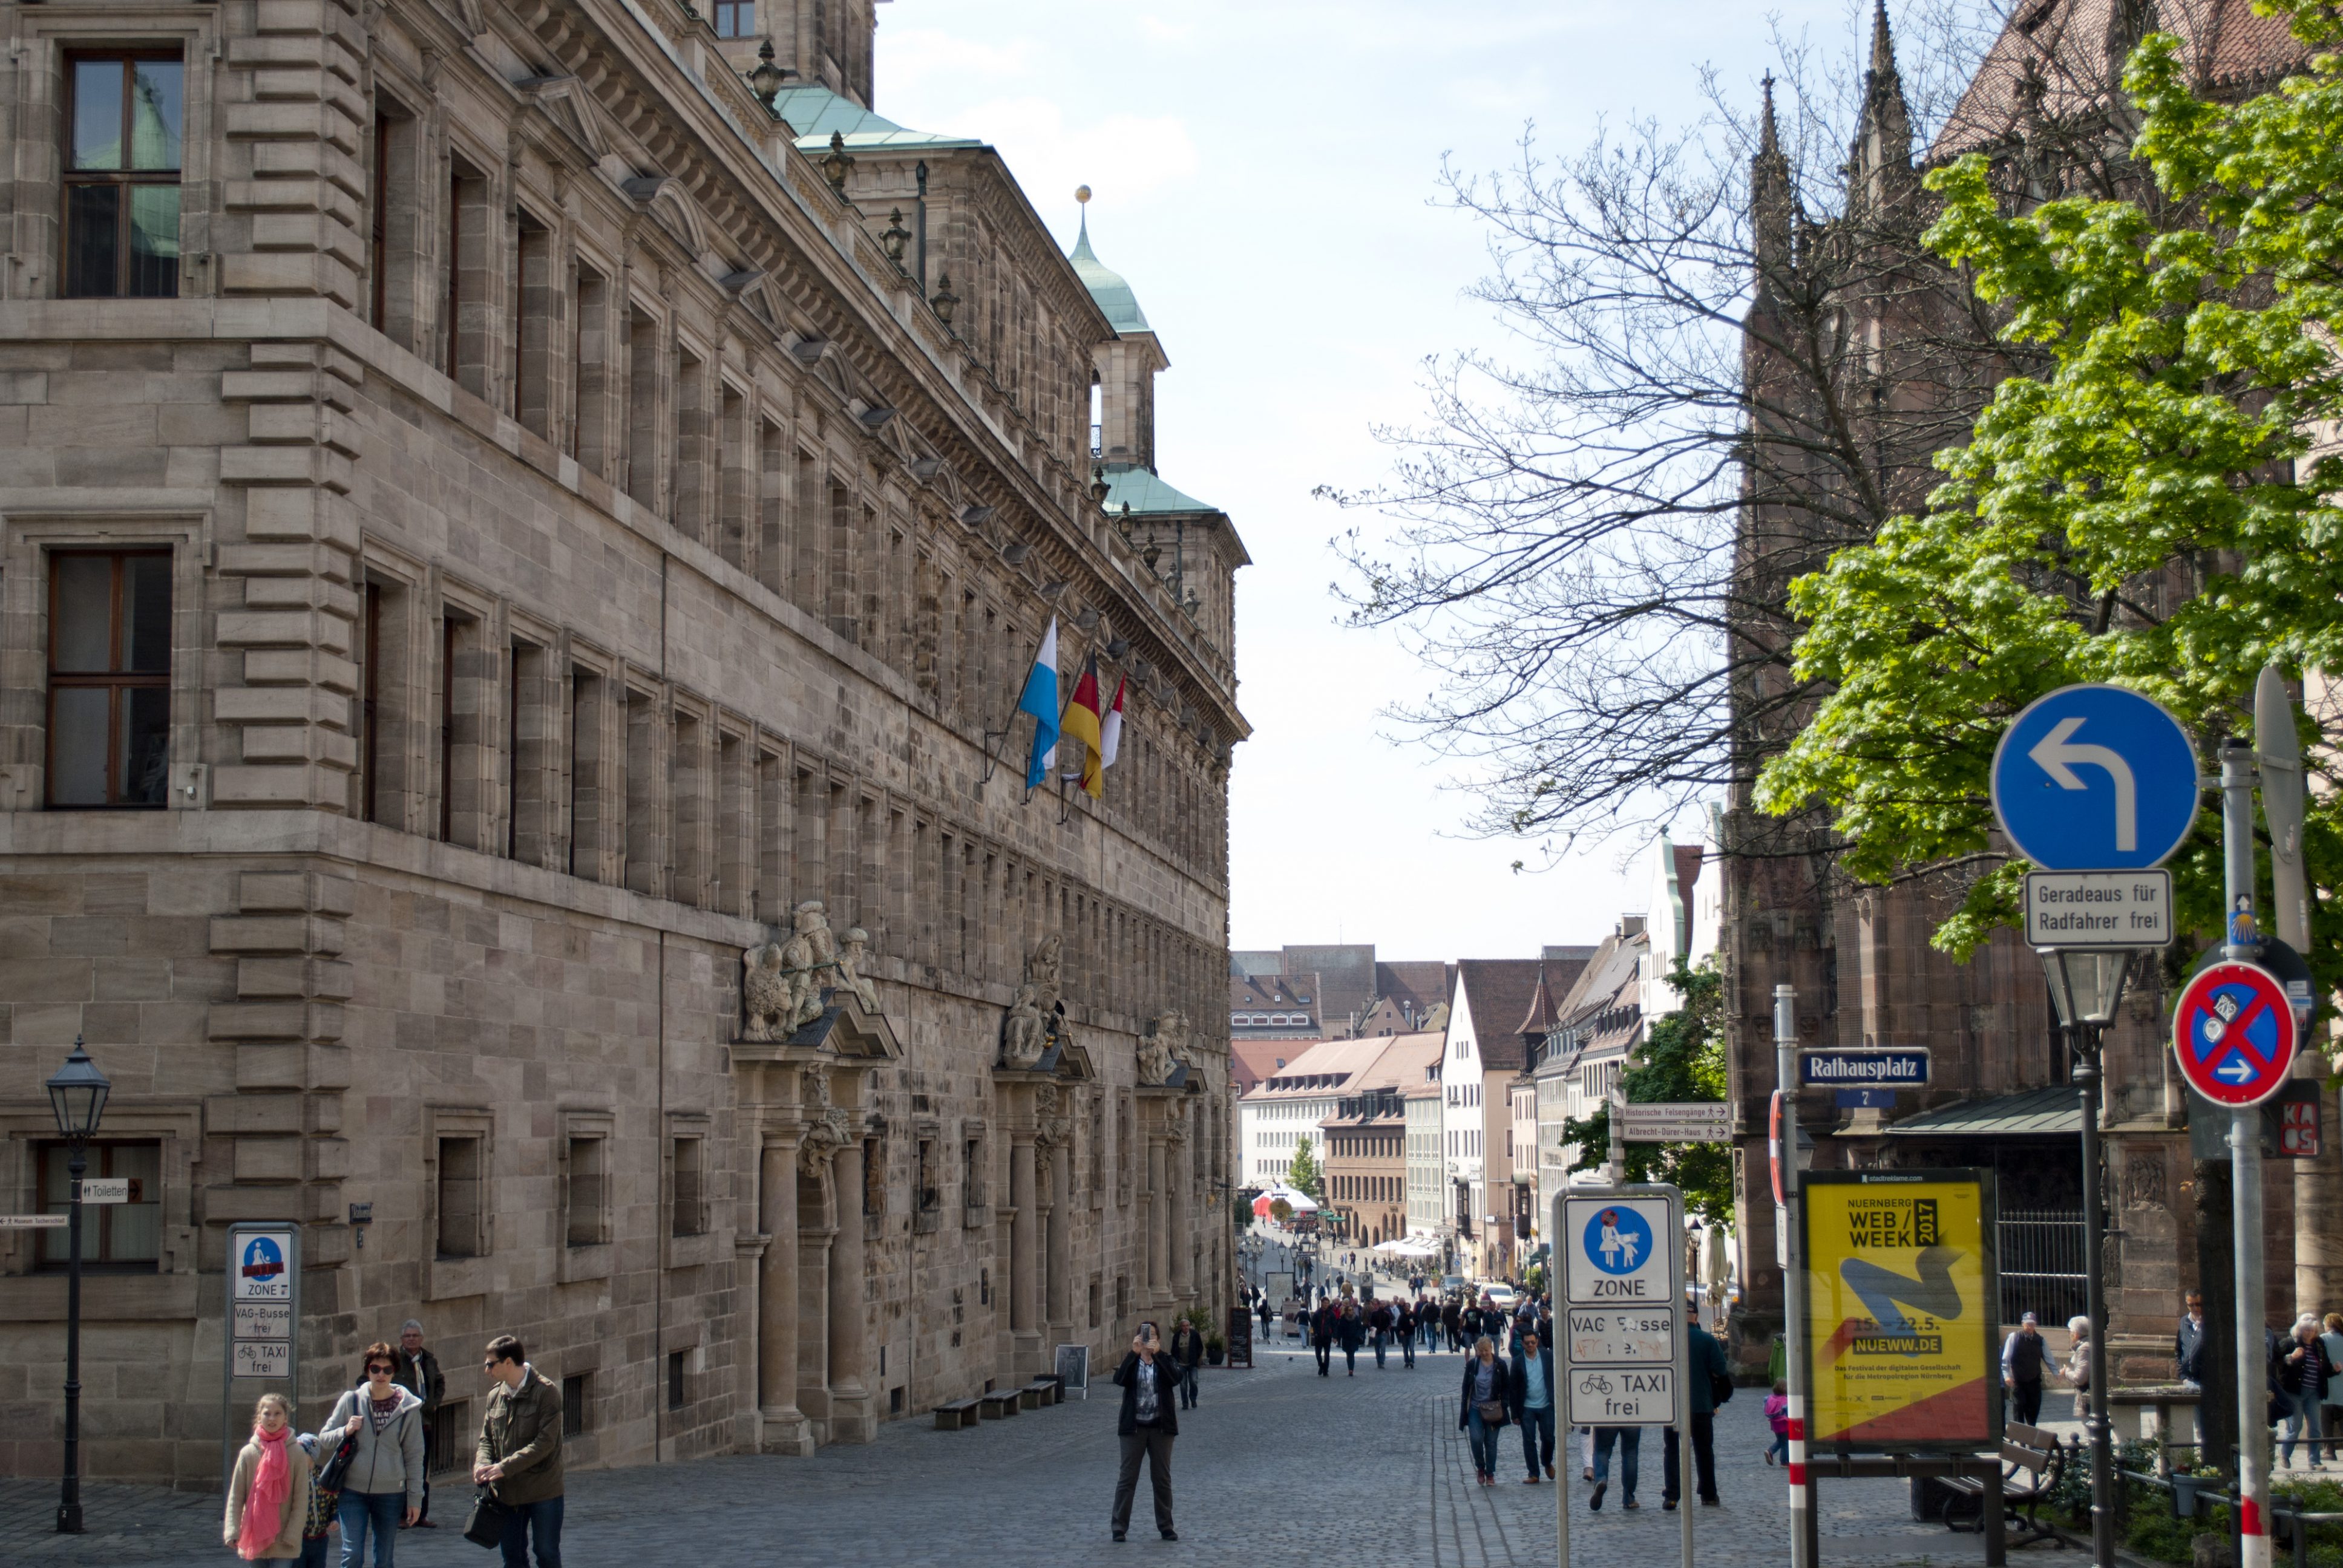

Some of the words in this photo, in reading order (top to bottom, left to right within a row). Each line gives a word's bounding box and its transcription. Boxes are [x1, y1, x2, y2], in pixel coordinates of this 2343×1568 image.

[2039, 885, 2122, 903] Geradeaus
[2132, 884, 2157, 901] für
[2039, 912, 2119, 930] Radfahrer
[2130, 910, 2158, 929] frei
[1810, 1056, 1916, 1080] Rathausplatz
[1861, 1091, 1869, 1105] 7
[1625, 1108, 1662, 1117] Historische
[1665, 1108, 1706, 1118] Felsengänge
[1628, 1127, 1701, 1137] Albrecht-Dürer-Haus
[92, 1184, 127, 1197] Toiletten
[1847, 1198, 1912, 1208] NUERNBERG
[1849, 1211, 1896, 1229] WEB
[1918, 1203, 1934, 1244] 2017
[1849, 1230, 1912, 1248] WEEK
[248, 1284, 277, 1295] ZONE
[1593, 1279, 1646, 1297] ZONE
[235, 1308, 289, 1319] VAG-Busse
[254, 1322, 270, 1333] frei
[1571, 1316, 1605, 1332] VAG
[1853, 1317, 1879, 1331] 15.
[1895, 1316, 1941, 1331] 22.5.
[261, 1346, 286, 1357] TAXI
[1855, 1338, 1939, 1352] NUEWW.DE
[252, 1361, 272, 1372] frei
[1620, 1374, 1666, 1393] TAXI
[1604, 1397, 1639, 1416] frei
